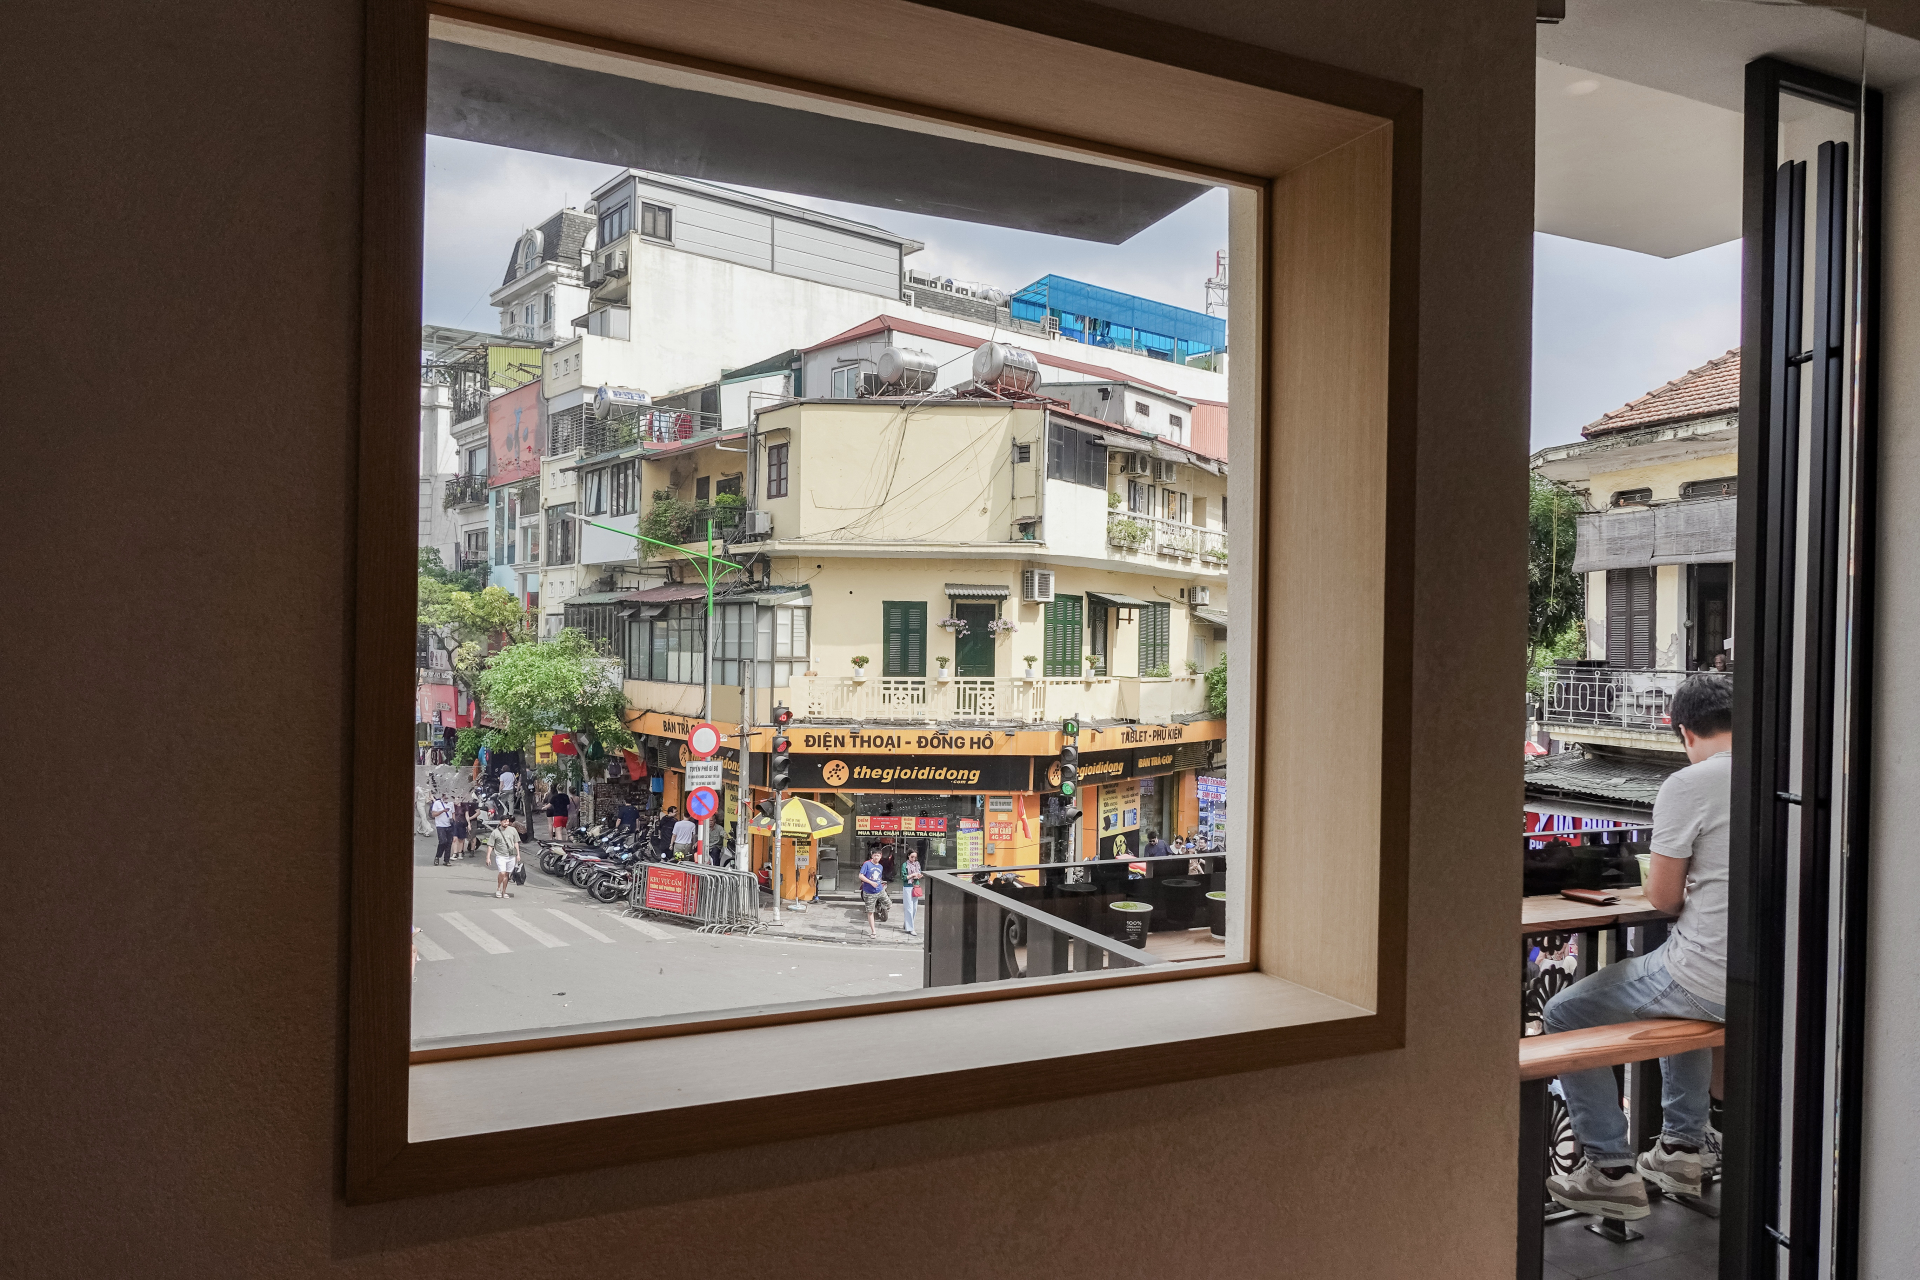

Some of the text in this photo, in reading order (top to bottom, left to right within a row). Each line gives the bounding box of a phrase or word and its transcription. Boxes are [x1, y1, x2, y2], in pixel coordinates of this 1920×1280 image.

[663, 719, 677, 734] BÁN
[1121, 730, 1148, 744] TABLET
[1152, 729, 1167, 743] PHỤ
[1167, 726, 1182, 742] KIỆN
[804, 731, 845, 751] ĐIỆN
[849, 734, 901, 752] THOẠI
[916, 730, 966, 750] ĐỒNG
[969, 730, 994, 750] HỒ
[853, 765, 981, 785] thegioididong
